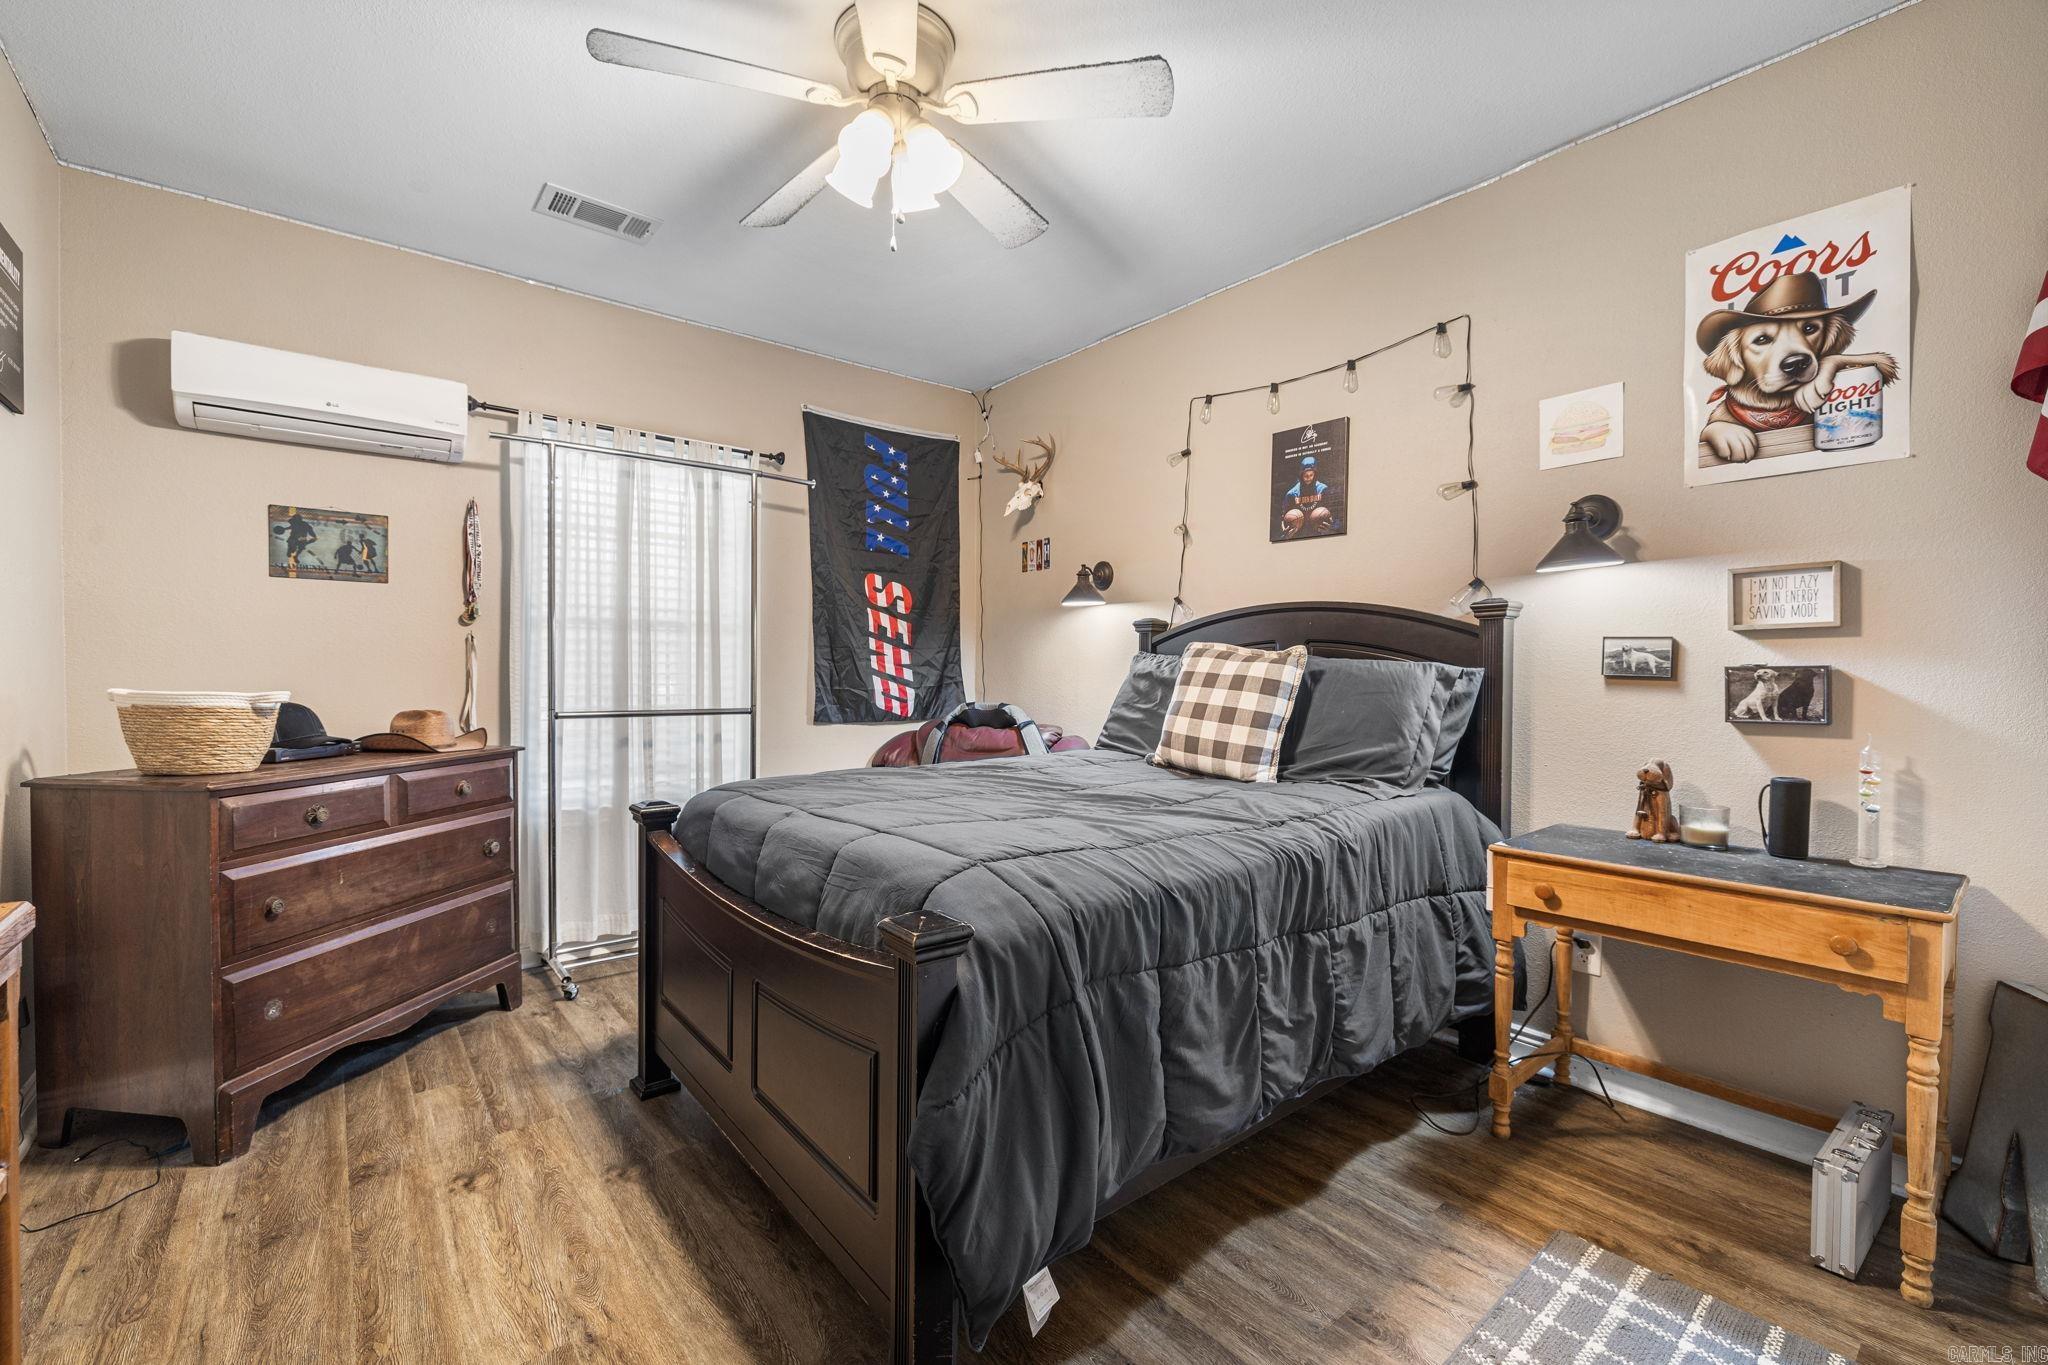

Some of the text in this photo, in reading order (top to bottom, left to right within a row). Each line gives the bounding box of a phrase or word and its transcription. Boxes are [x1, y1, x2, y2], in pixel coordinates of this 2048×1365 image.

[1710, 231, 1877, 302] Coors
[1826, 380, 1882, 402] oors
[1819, 396, 1873, 415] LIGHT
[864, 431, 916, 718] FULL SEND
[1750, 574, 1819, 592] I'M NOT LAZY
[1750, 588, 1819, 605] I'M IN ENERGY
[1749, 602, 1818, 620] SAVING MODE
